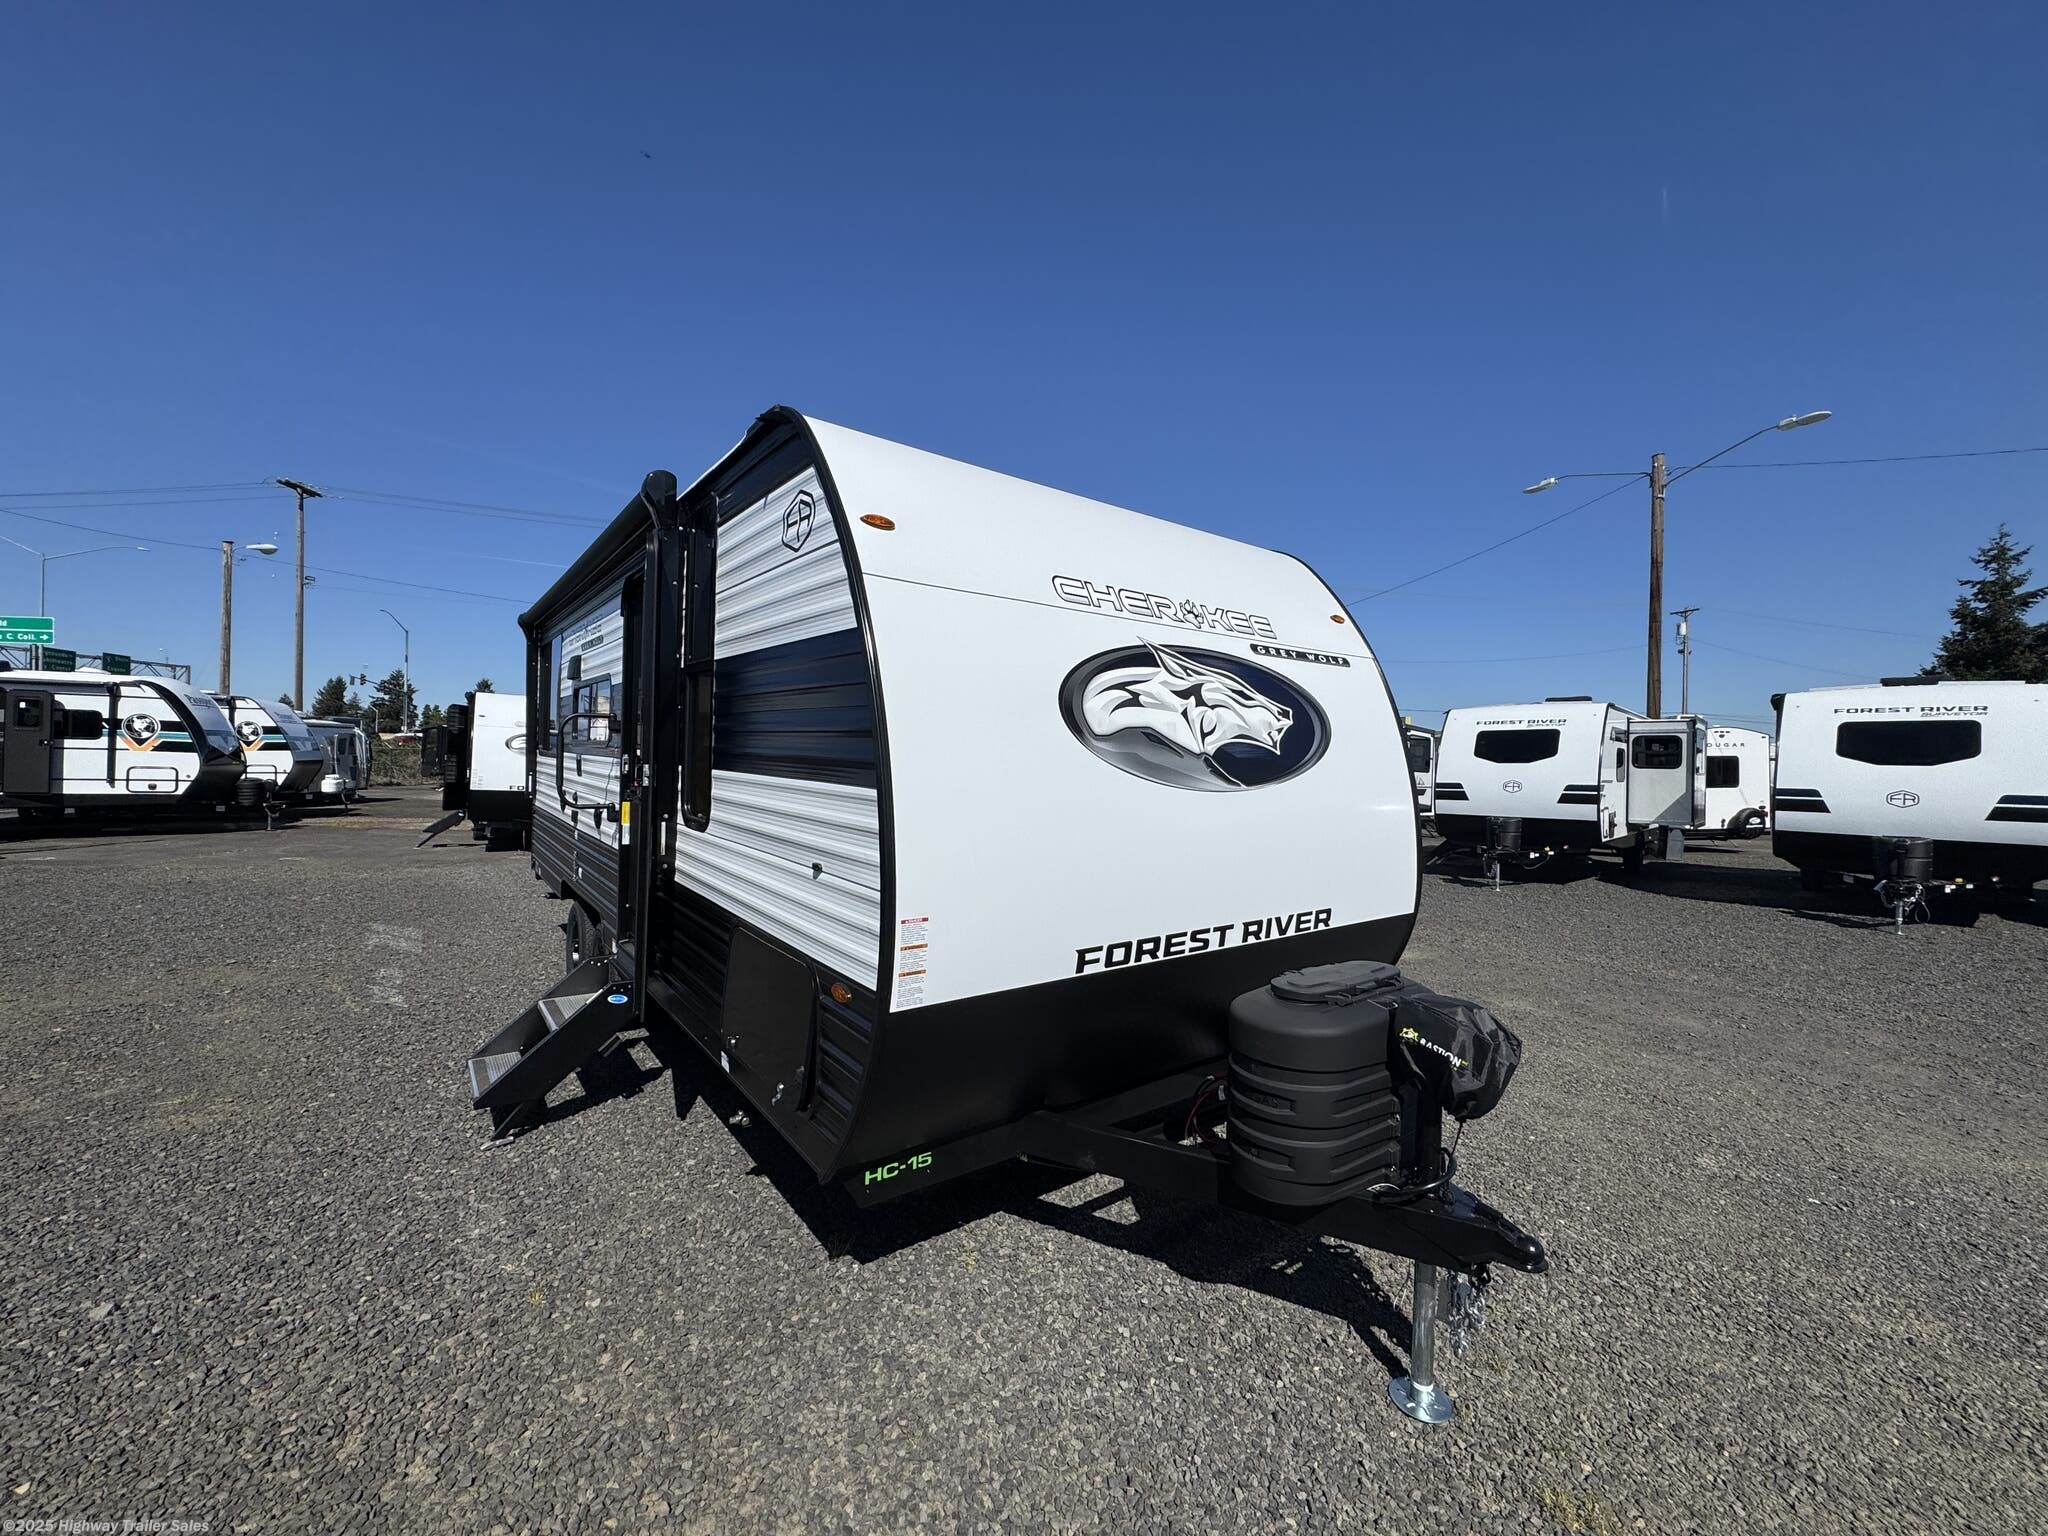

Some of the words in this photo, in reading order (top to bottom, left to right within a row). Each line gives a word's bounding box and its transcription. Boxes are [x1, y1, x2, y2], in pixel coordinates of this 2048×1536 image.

[1256, 645, 1297, 659] GREY
[1306, 653, 1344, 665] WOLF
[1834, 706, 1915, 714] FOREST
[1075, 924, 1234, 975] FOREST
[1241, 908, 1332, 943] RIVER
[864, 1151, 932, 1185] HC-15
